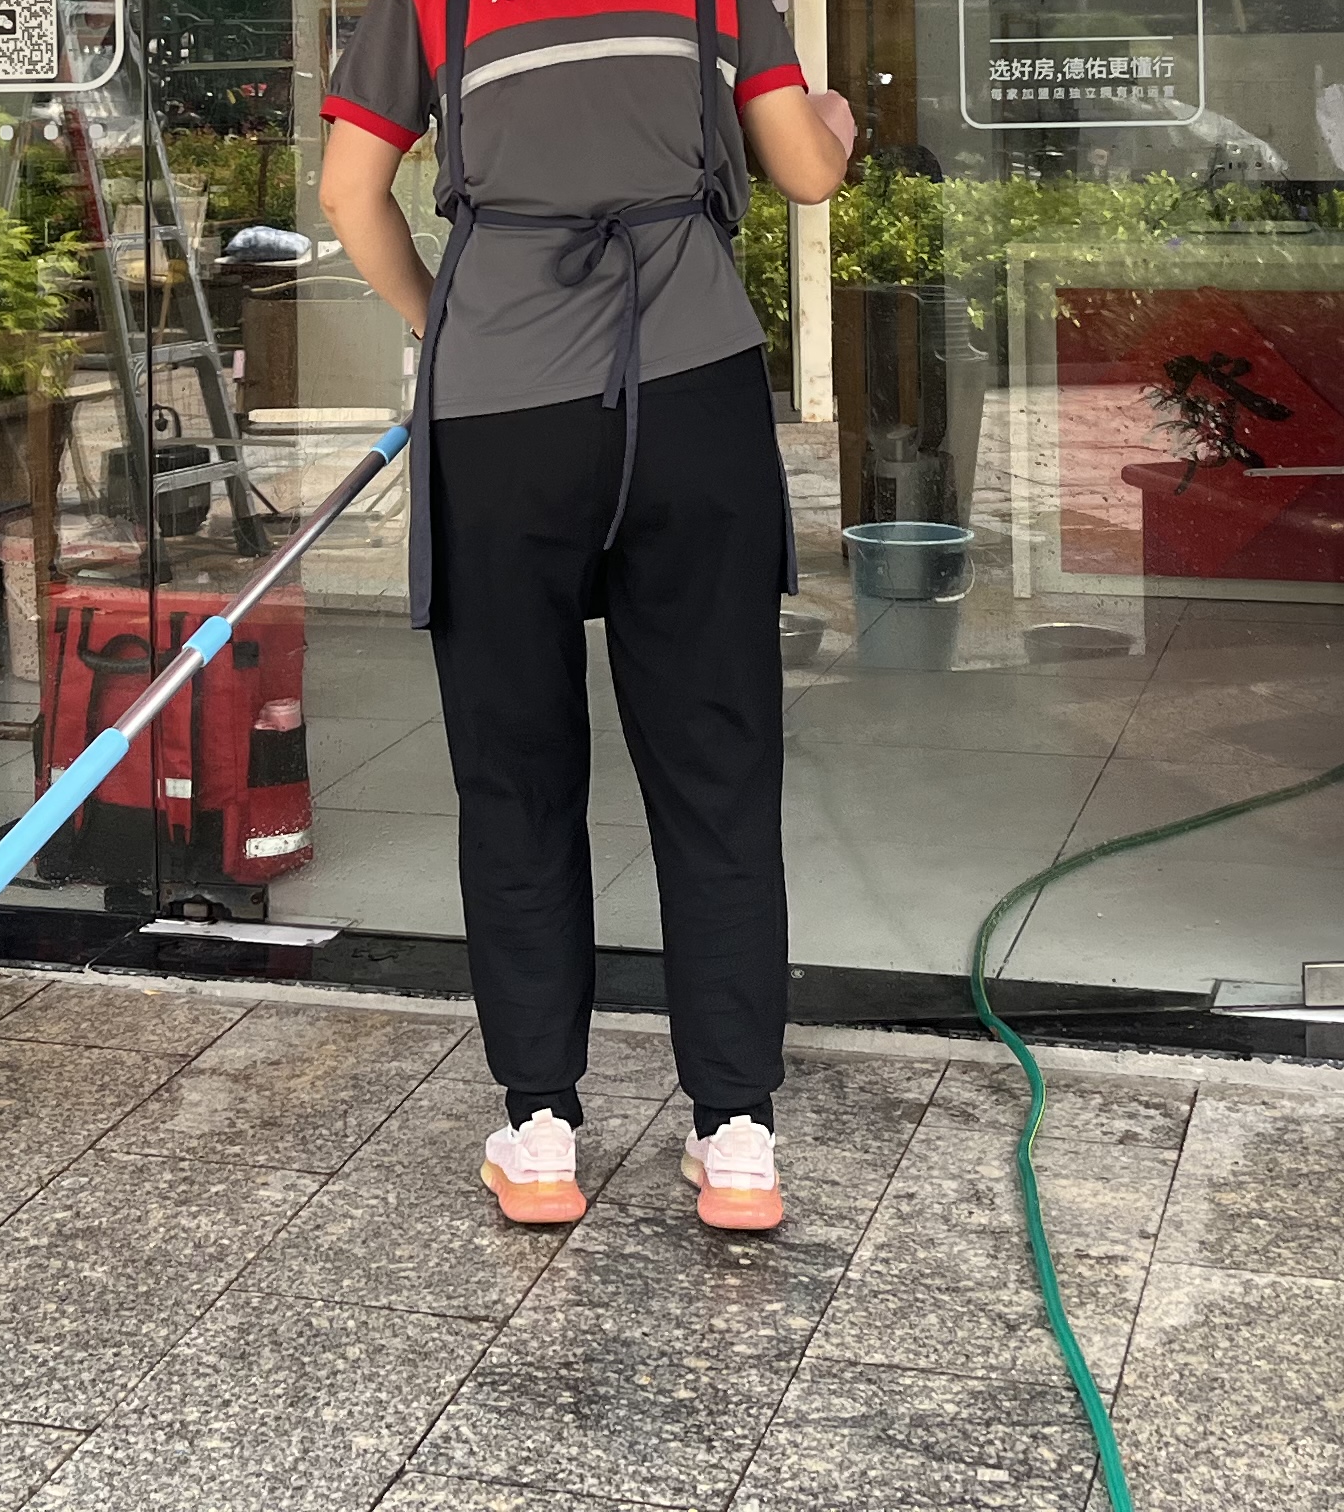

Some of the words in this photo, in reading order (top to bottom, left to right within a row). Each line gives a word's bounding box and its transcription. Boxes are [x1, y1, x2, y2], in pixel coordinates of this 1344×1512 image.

[989, 56, 1175, 83] 选好房,德佑更懂行
